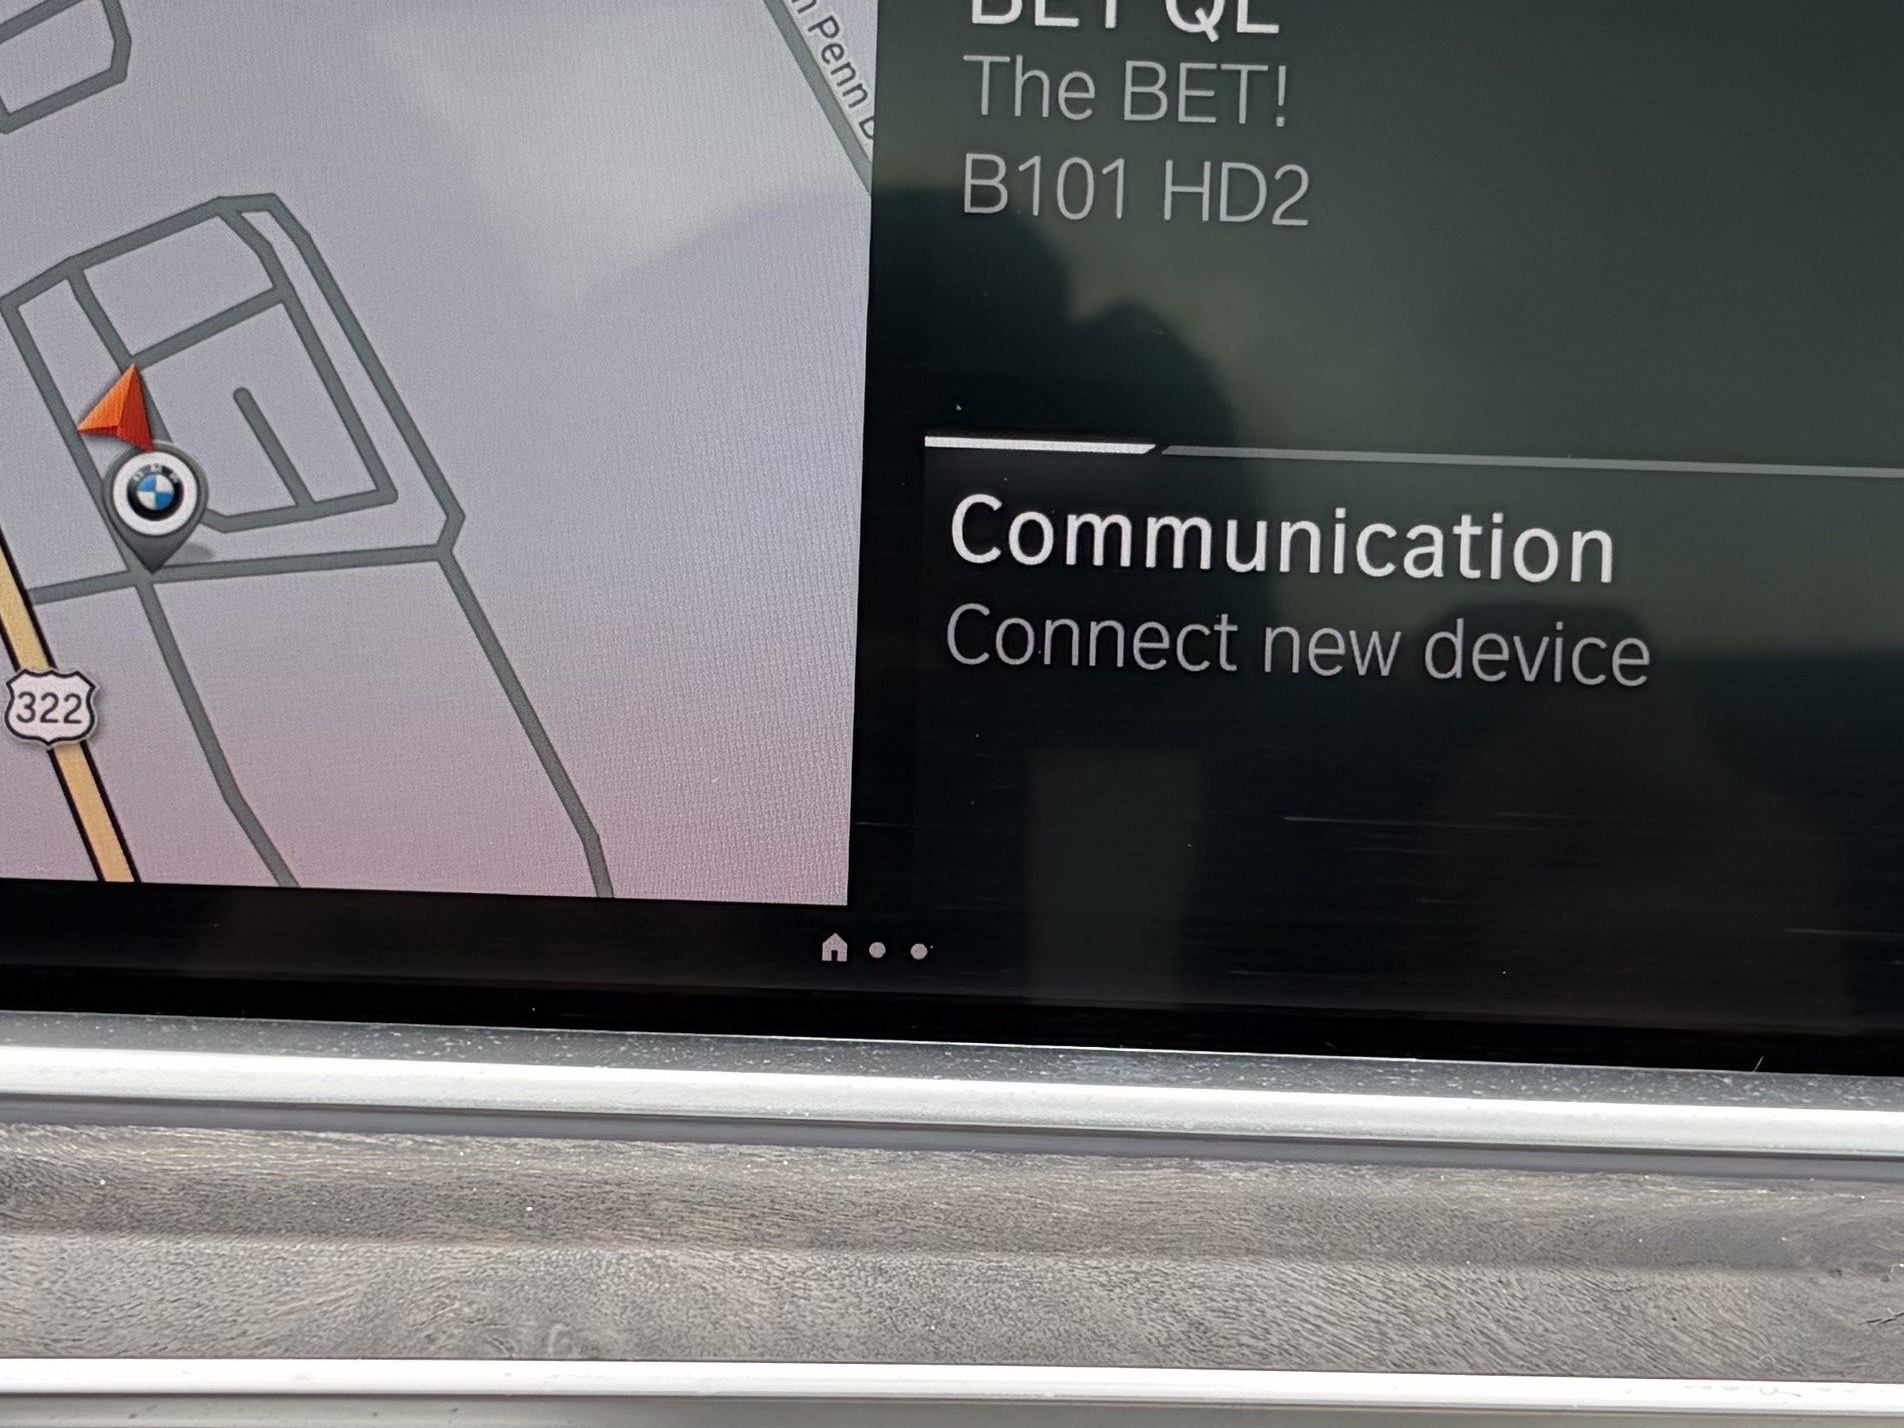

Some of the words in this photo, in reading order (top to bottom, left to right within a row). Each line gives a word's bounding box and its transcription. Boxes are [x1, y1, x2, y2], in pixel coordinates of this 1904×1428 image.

[807, 14, 869, 109] Penn
[962, 54, 1096, 121] The
[1123, 60, 1289, 128] BET!
[963, 152, 1125, 222] B101
[1163, 159, 1311, 227] HD2
[950, 493, 1615, 584] Communication
[946, 602, 1239, 673] Connect
[1264, 624, 1402, 677] new
[1424, 618, 1651, 688] device
[15, 691, 83, 725] 322
